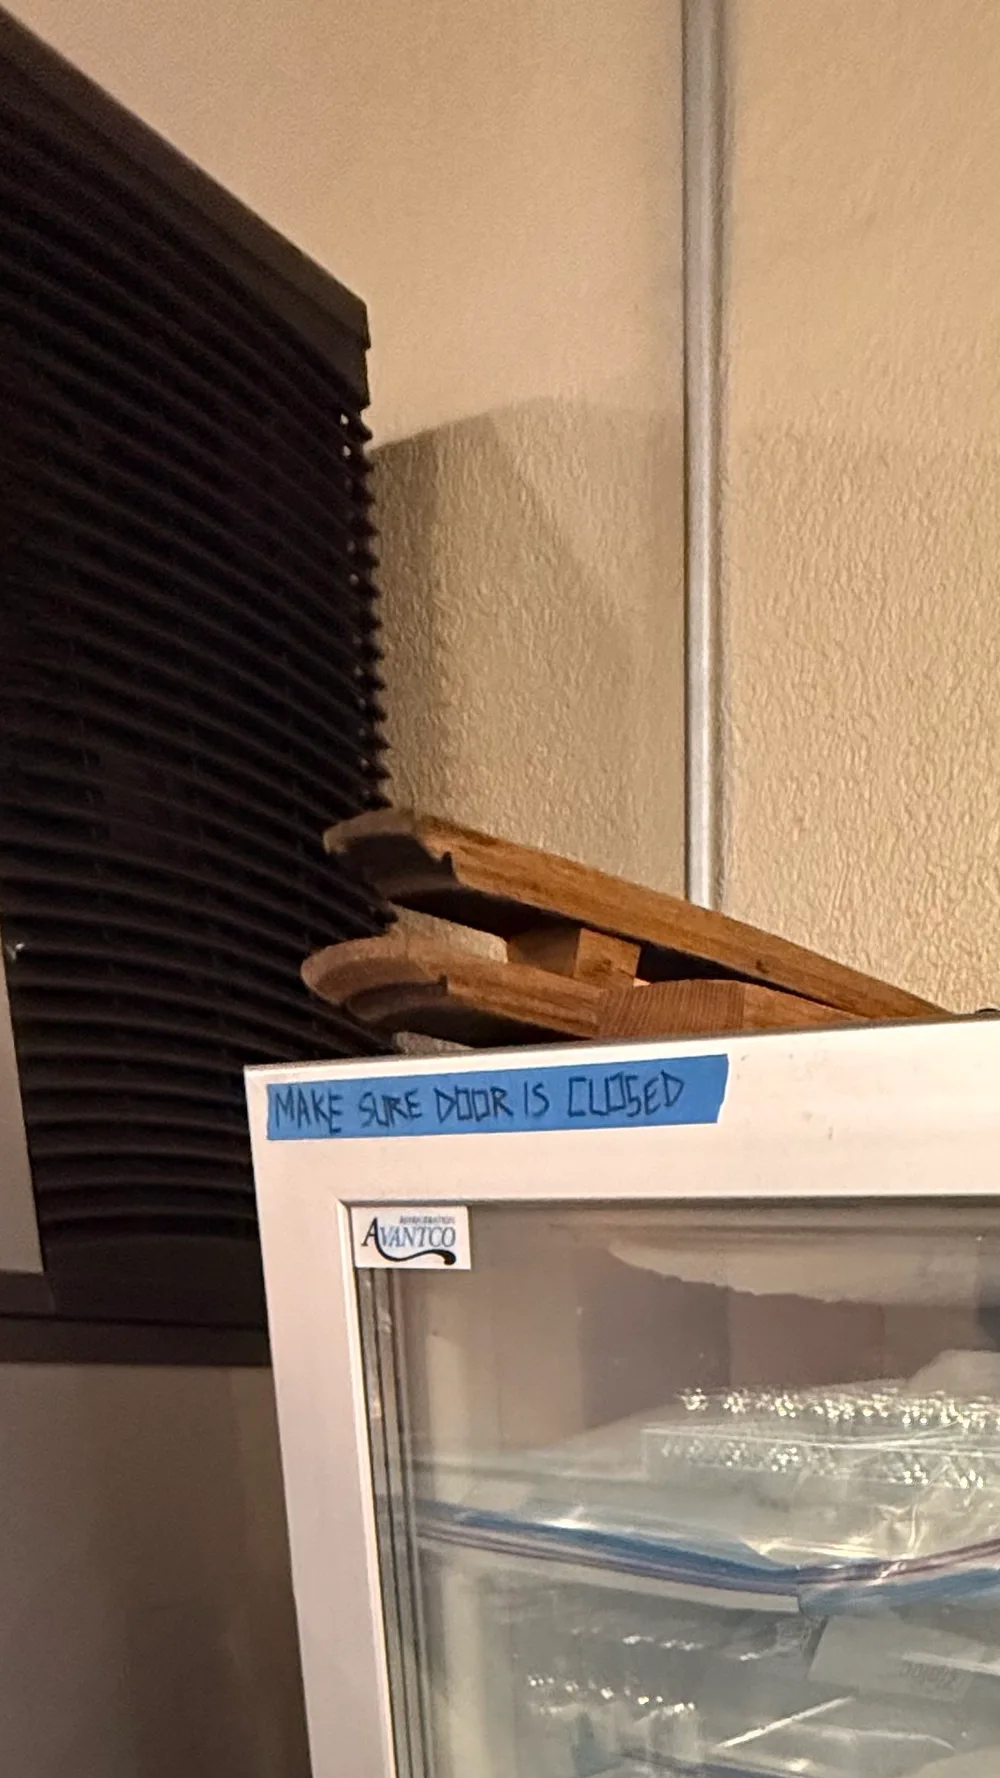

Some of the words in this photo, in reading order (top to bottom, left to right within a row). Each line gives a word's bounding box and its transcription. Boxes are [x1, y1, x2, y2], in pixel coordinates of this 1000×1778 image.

[275, 1086, 343, 1134] MAKE
[358, 1087, 423, 1128] SURE
[433, 1085, 514, 1124] DOOR
[523, 1080, 550, 1118] IS
[567, 1069, 685, 1118] CLOSED
[361, 1216, 457, 1265] AVANTCO
